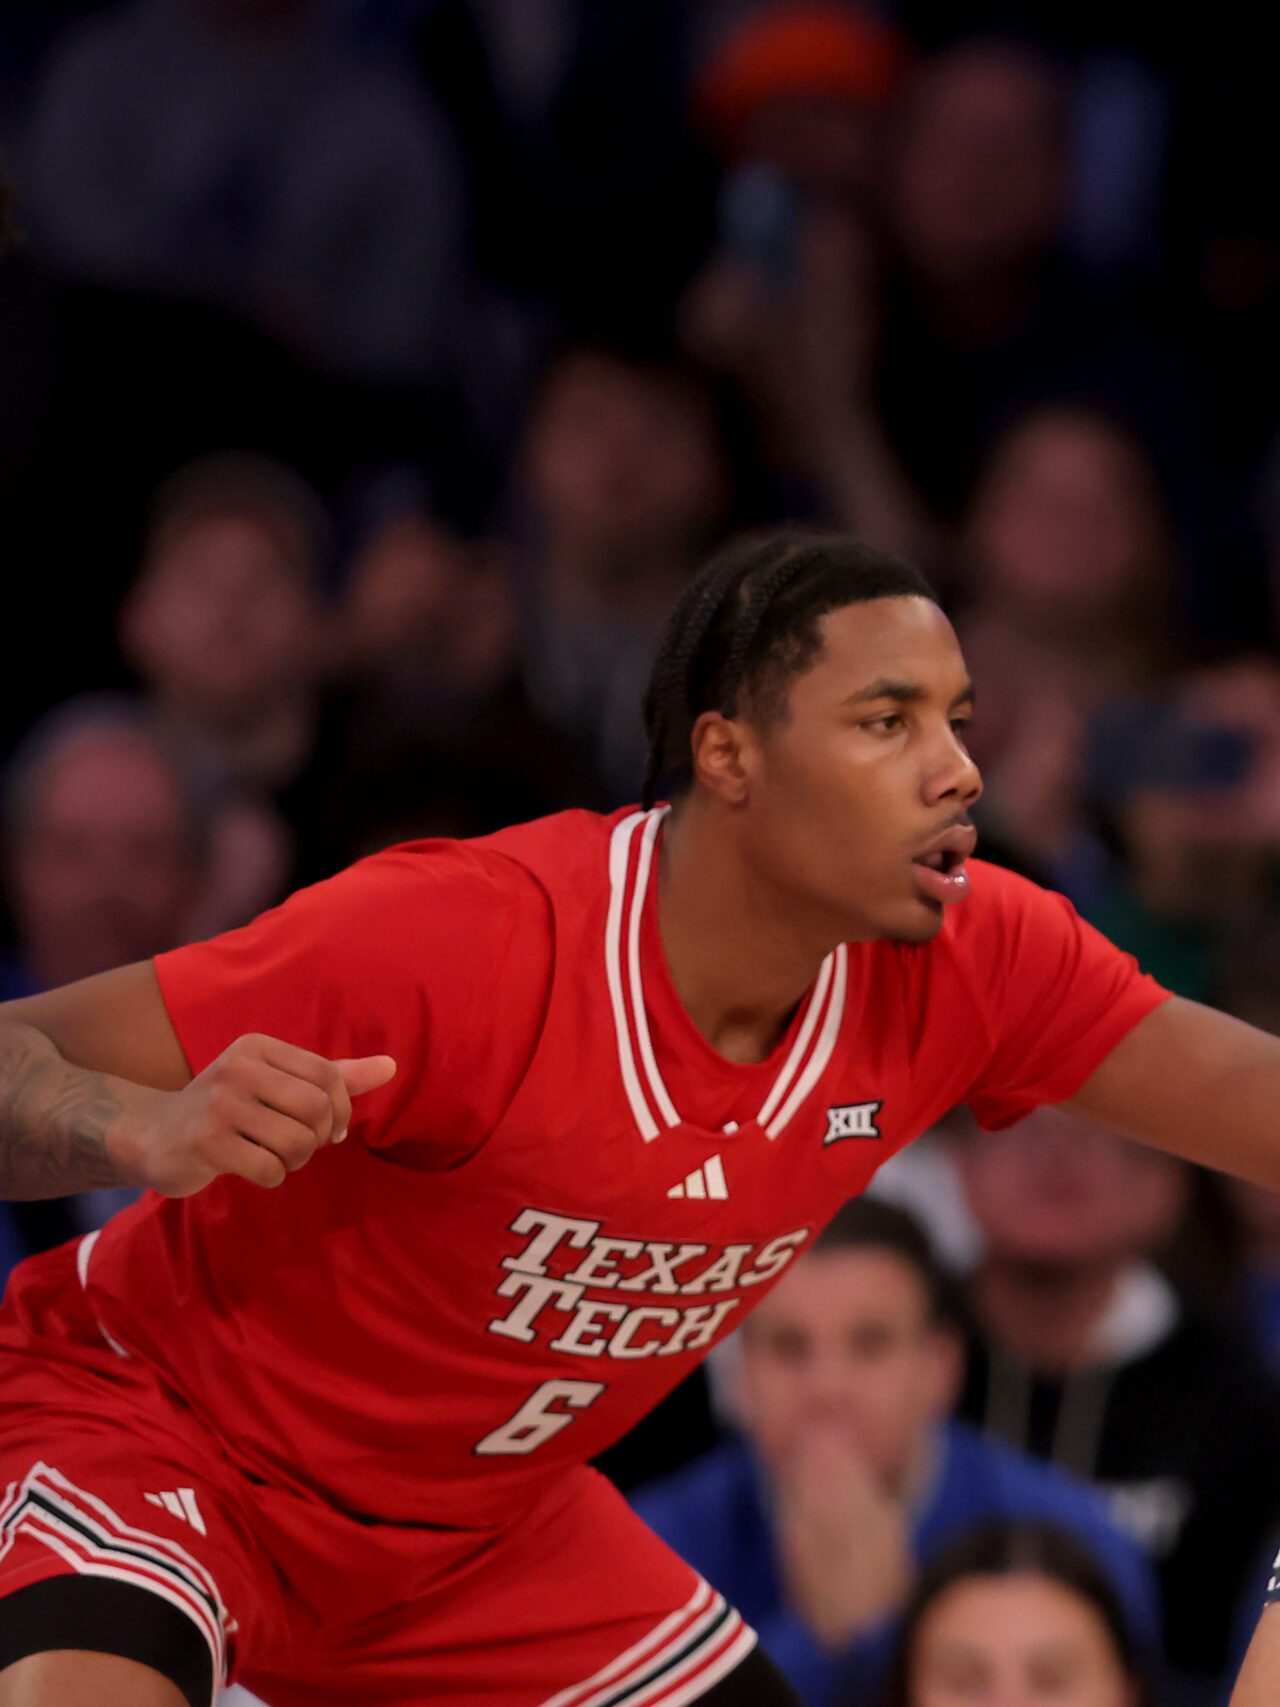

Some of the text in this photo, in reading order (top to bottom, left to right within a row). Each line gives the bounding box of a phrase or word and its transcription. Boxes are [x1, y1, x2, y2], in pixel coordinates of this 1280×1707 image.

[500, 1207, 810, 1295] TEXAS
[488, 1270, 742, 1360] TECH
[472, 1378, 607, 1456] 6
